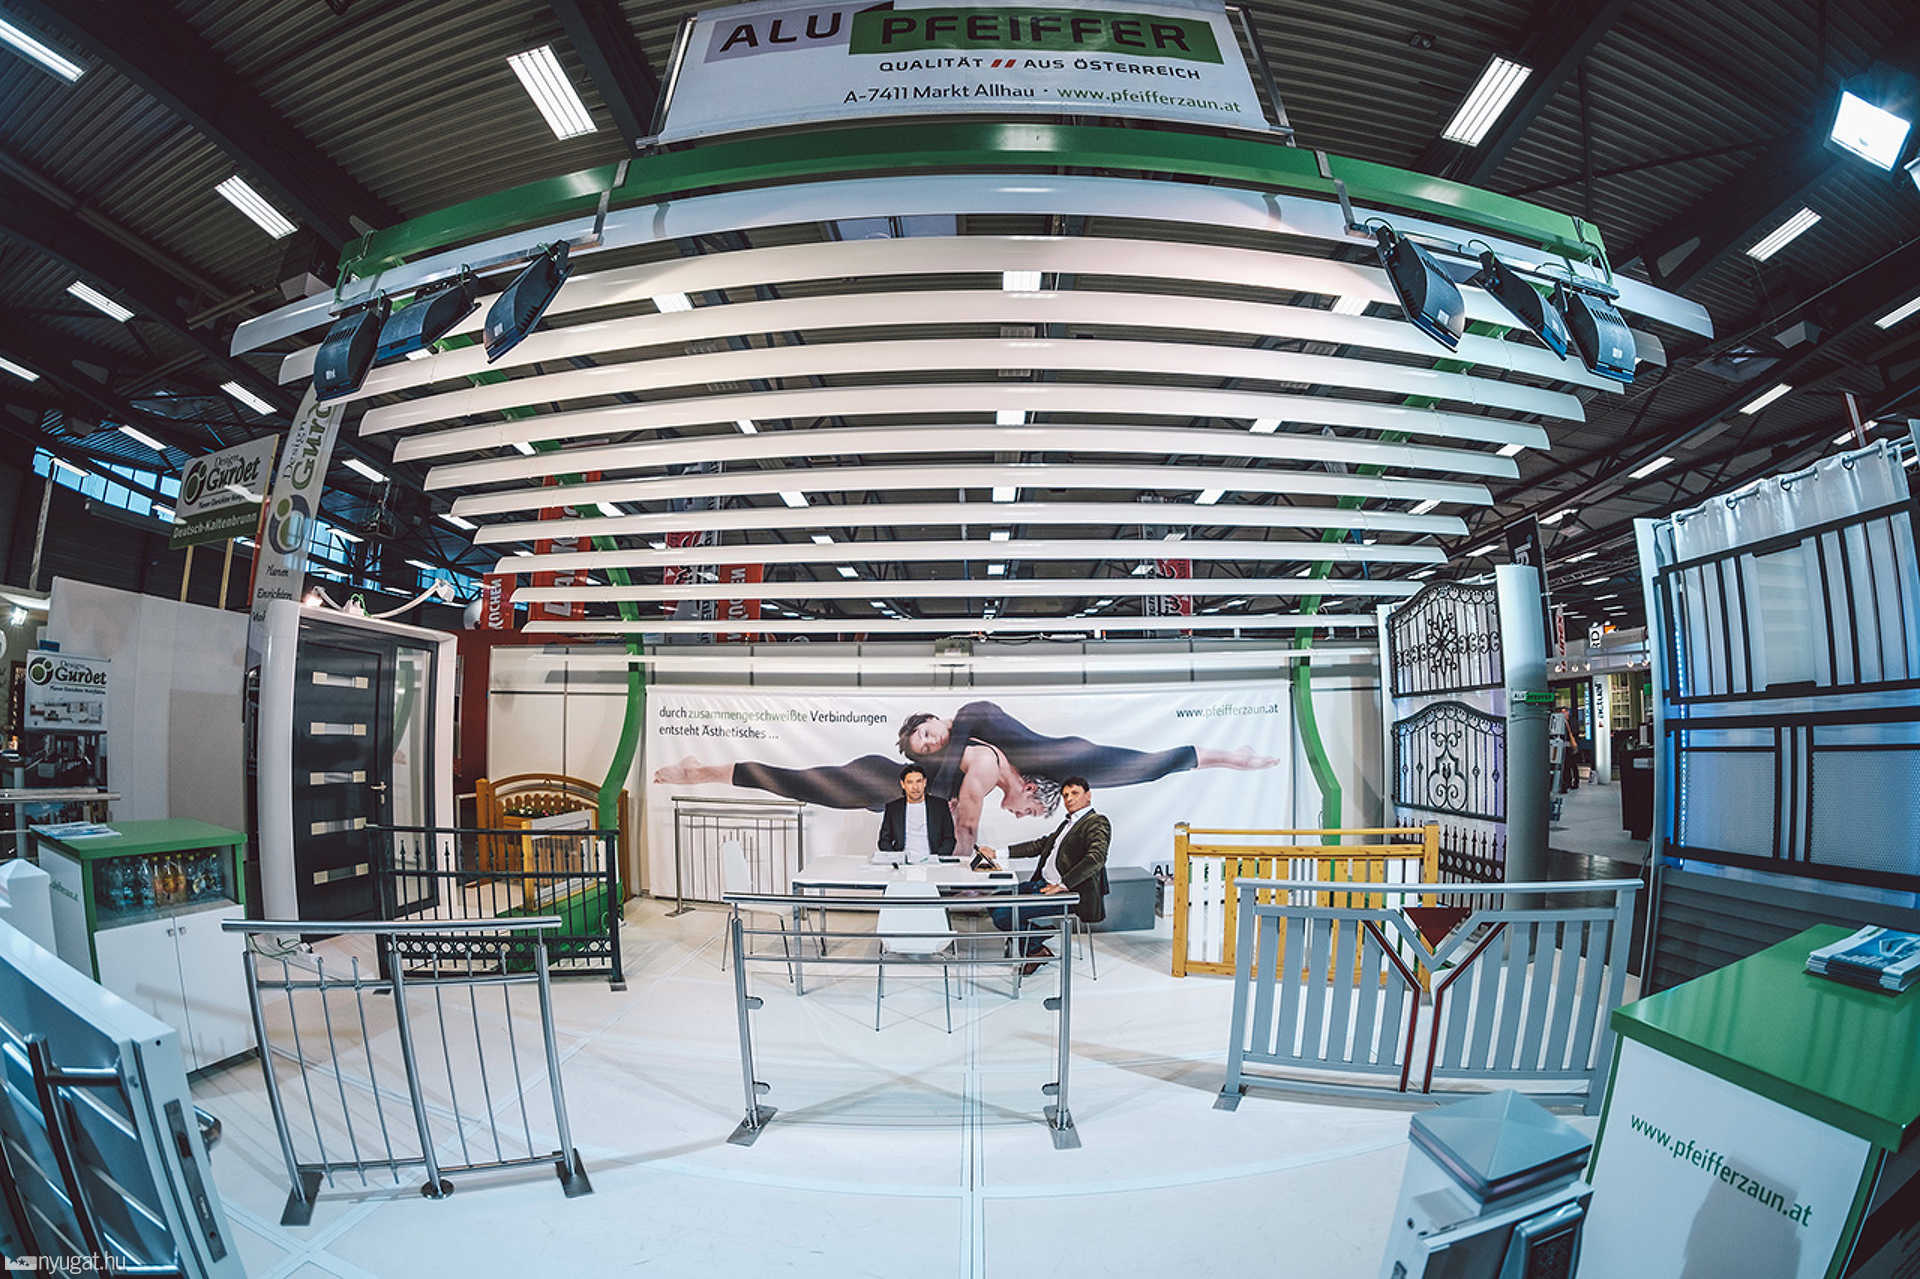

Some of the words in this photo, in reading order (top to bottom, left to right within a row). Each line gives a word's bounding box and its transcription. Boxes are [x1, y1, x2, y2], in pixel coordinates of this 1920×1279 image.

[719, 12, 842, 53] ALU
[881, 15, 1191, 52] PFEIFFER
[879, 57, 984, 72] QUALITÄT
[1023, 58, 1065, 69] AUS
[1074, 58, 1201, 80] ÖSTERREICH
[843, 86, 908, 104] A-7411
[913, 84, 970, 99] Markt
[974, 83, 1035, 98] Allhau
[1056, 87, 1241, 113] www.pfeifferzaun.at
[206, 457, 261, 491] Gurdet
[55, 667, 107, 685] Gurdet
[659, 707, 687, 718] durch
[688, 709, 808, 723] zusammengeschweißte
[809, 711, 888, 726] Verbindungen
[659, 725, 700, 736] entsteht
[701, 725, 767, 739] Ästhetisches
[1631, 1114, 1813, 1227] www.pfeifferzaun.at
